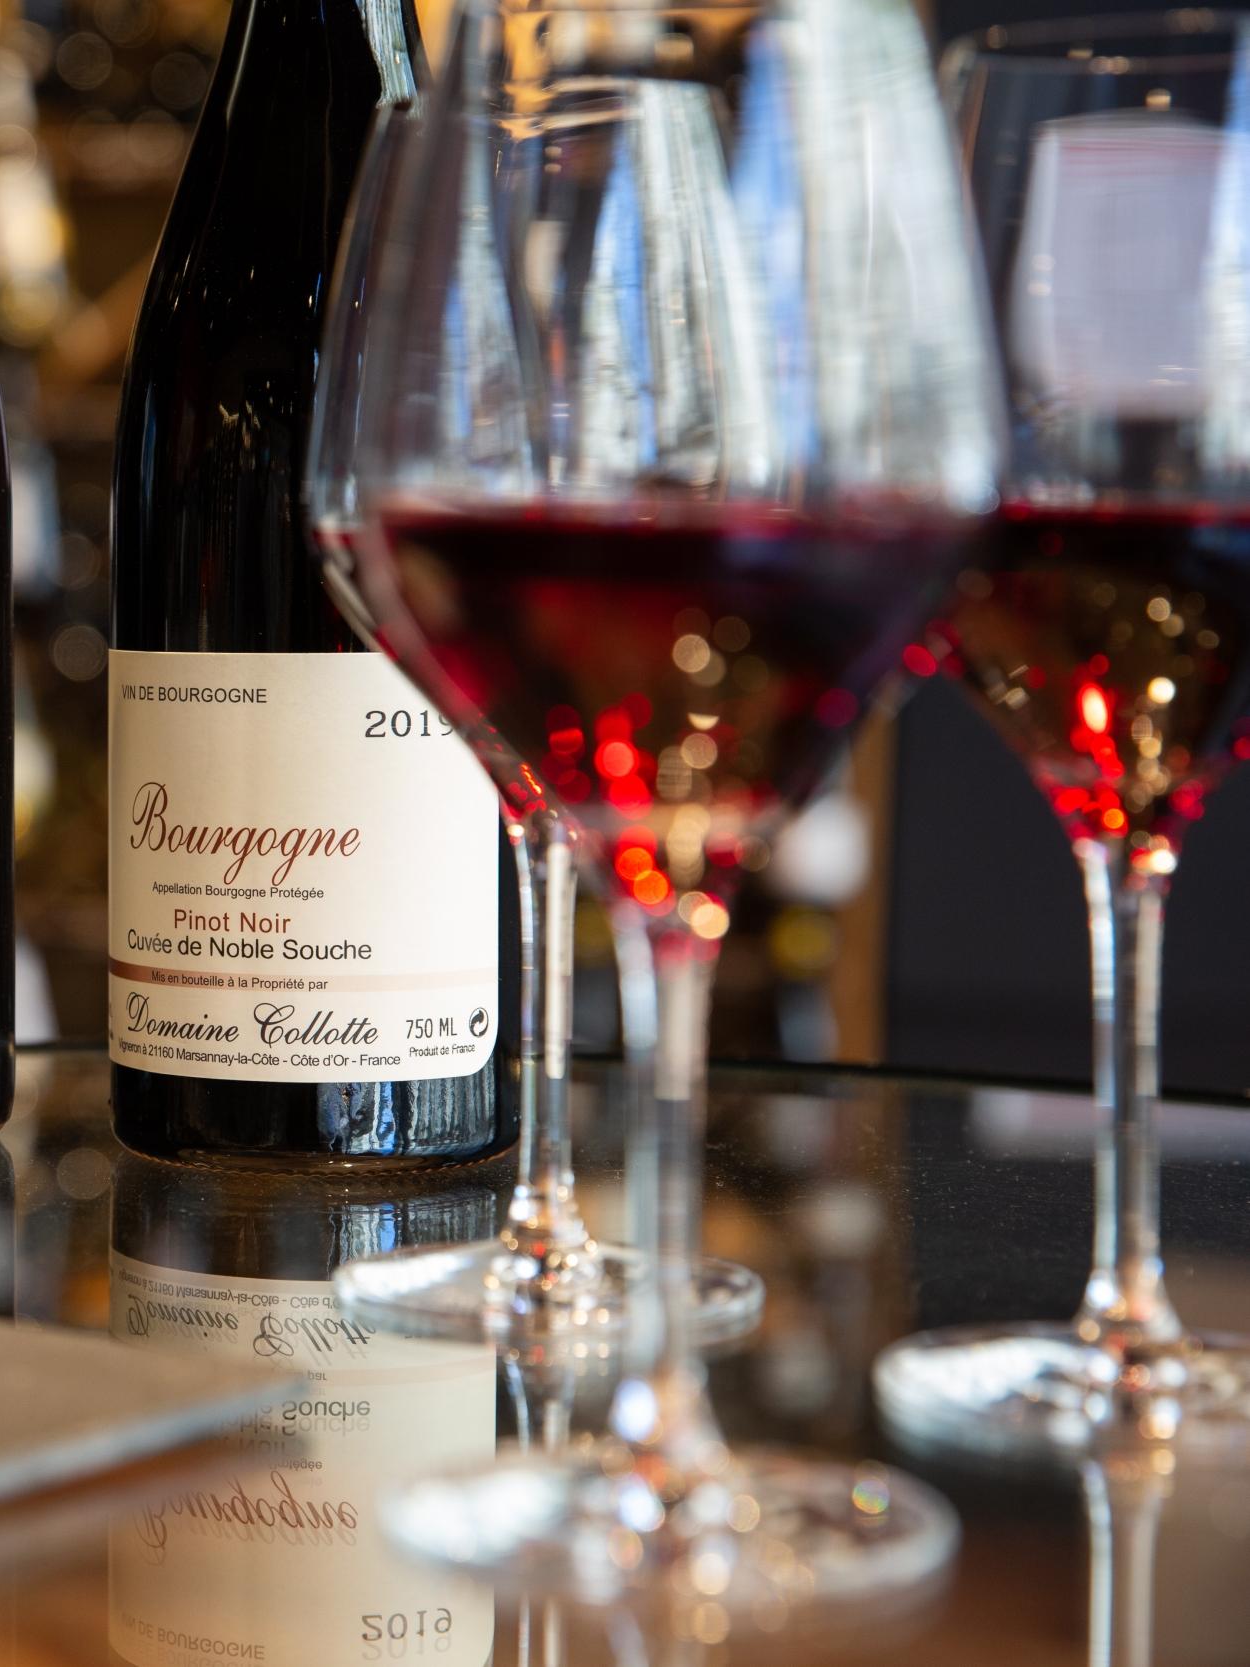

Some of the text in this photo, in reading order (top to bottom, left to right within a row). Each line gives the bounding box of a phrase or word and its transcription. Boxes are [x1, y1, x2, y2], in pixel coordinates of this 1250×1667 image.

[121, 684, 268, 703] VIN DE BOURGOGNE
[130, 781, 361, 886] Bourgogne
[152, 880, 324, 901] Appellation Bourgogne Protégée
[174, 909, 291, 933] Pinot Noir
[127, 928, 372, 960] Cuvée de Noble Souche
[151, 971, 328, 992] Mis en bouteille à la Propriété par
[125, 991, 239, 1043] Domaine
[253, 1002, 378, 1048] Collotte
[406, 1017, 458, 1039] 750 ML
[148, 1044, 174, 1059] 21160
[176, 1048, 279, 1066] Marsannay-la-Côte
[290, 1053, 320, 1067] Côte
[322, 1054, 349, 1067] d'Or
[359, 1053, 401, 1067] France
[409, 1043, 476, 1057] Produit de France
